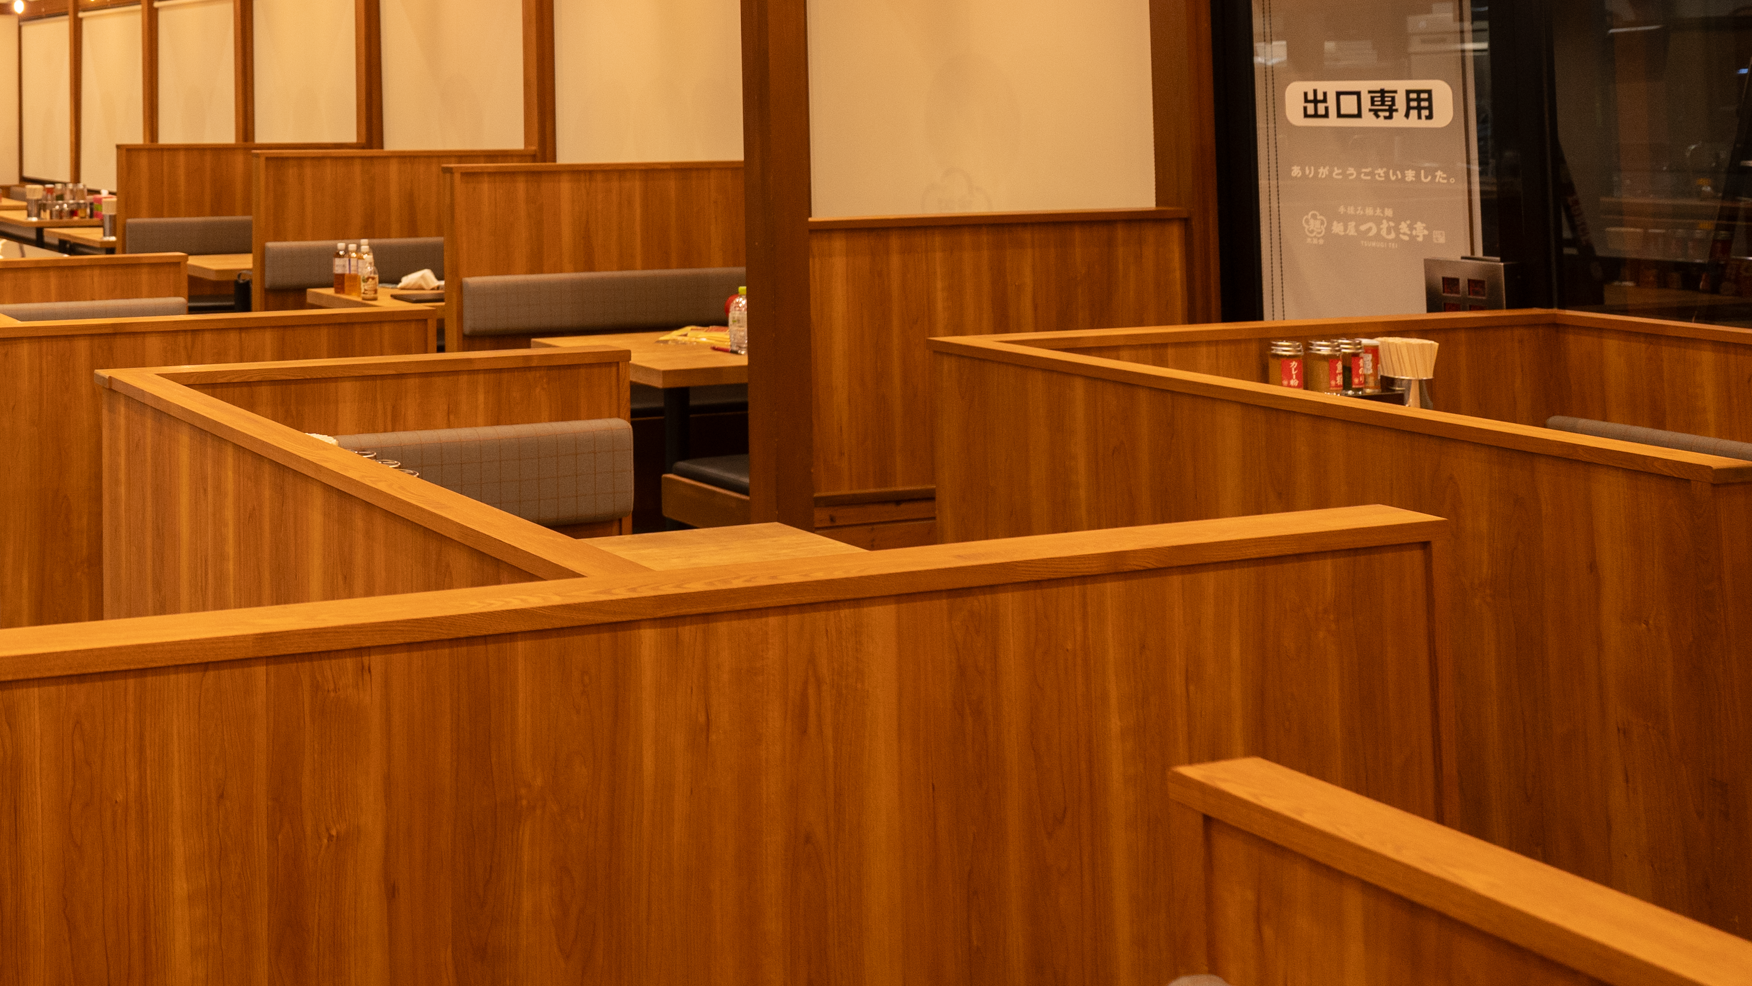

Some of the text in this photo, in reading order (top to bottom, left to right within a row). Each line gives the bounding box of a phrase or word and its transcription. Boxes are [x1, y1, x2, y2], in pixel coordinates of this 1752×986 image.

[1302, 87, 1435, 121] 出口専用
[1290, 165, 1456, 184] ありがとうございました。
[1331, 219, 1429, 242] 麺屋つむぎ亭
